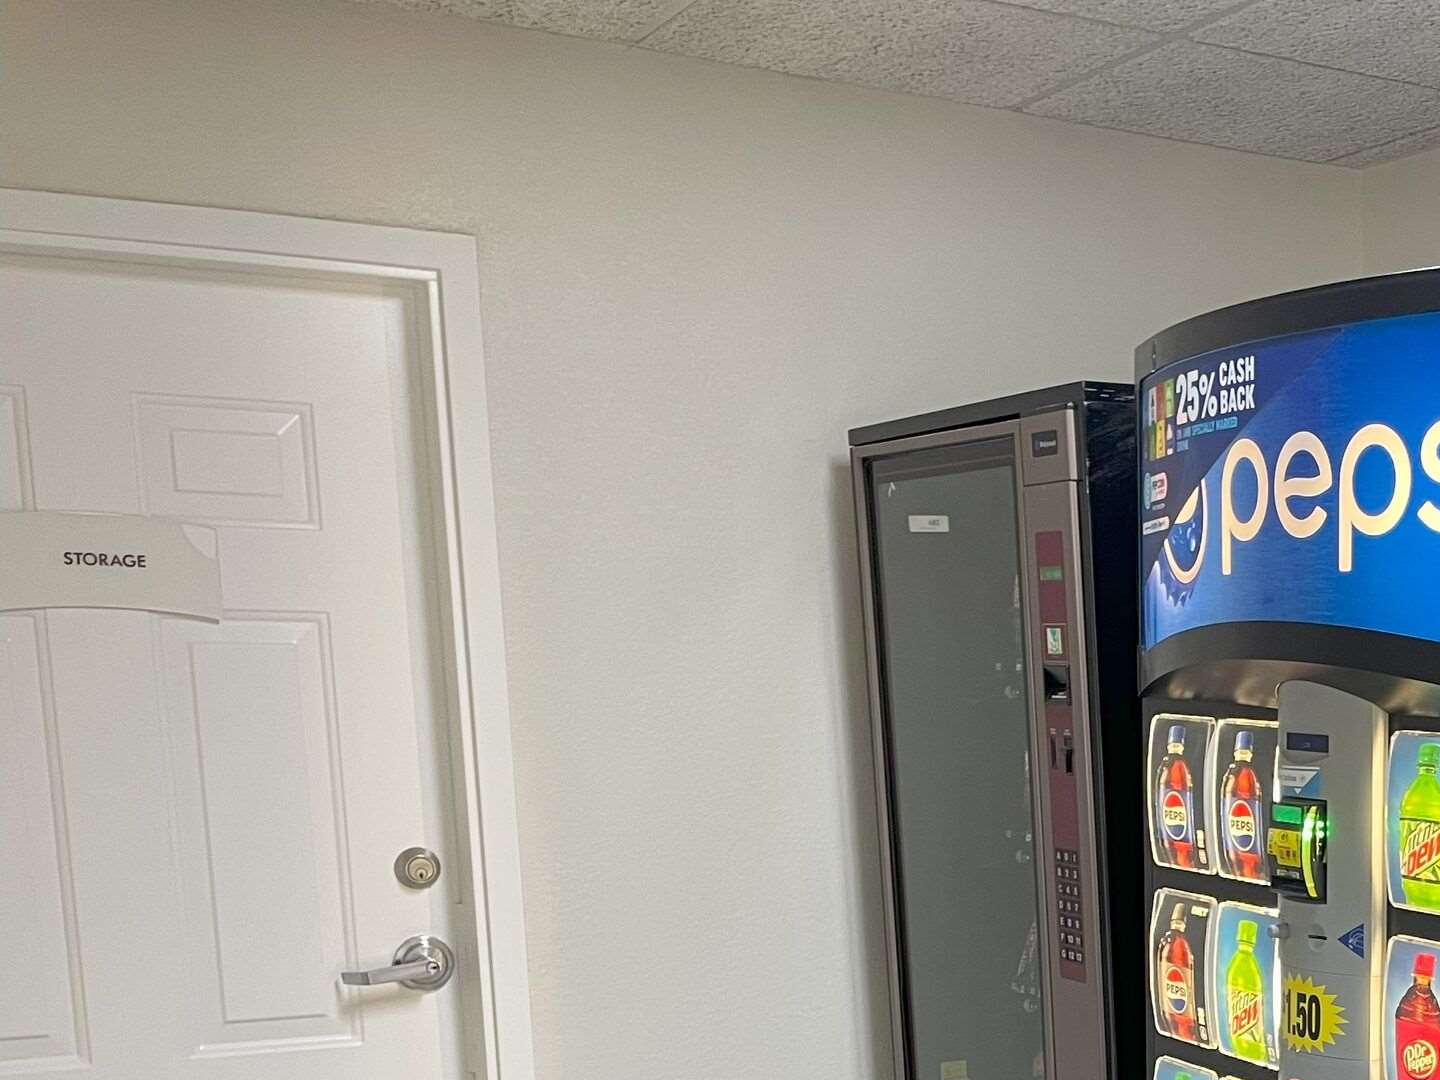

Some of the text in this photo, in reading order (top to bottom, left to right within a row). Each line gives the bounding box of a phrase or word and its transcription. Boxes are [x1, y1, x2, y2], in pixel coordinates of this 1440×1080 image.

[1219, 355, 1255, 387] CASH
[1175, 369, 1216, 425] 25%
[1220, 384, 1256, 414] BACK
[63, 551, 147, 568] STORAGE
[1166, 983, 1186, 997] PEPS
